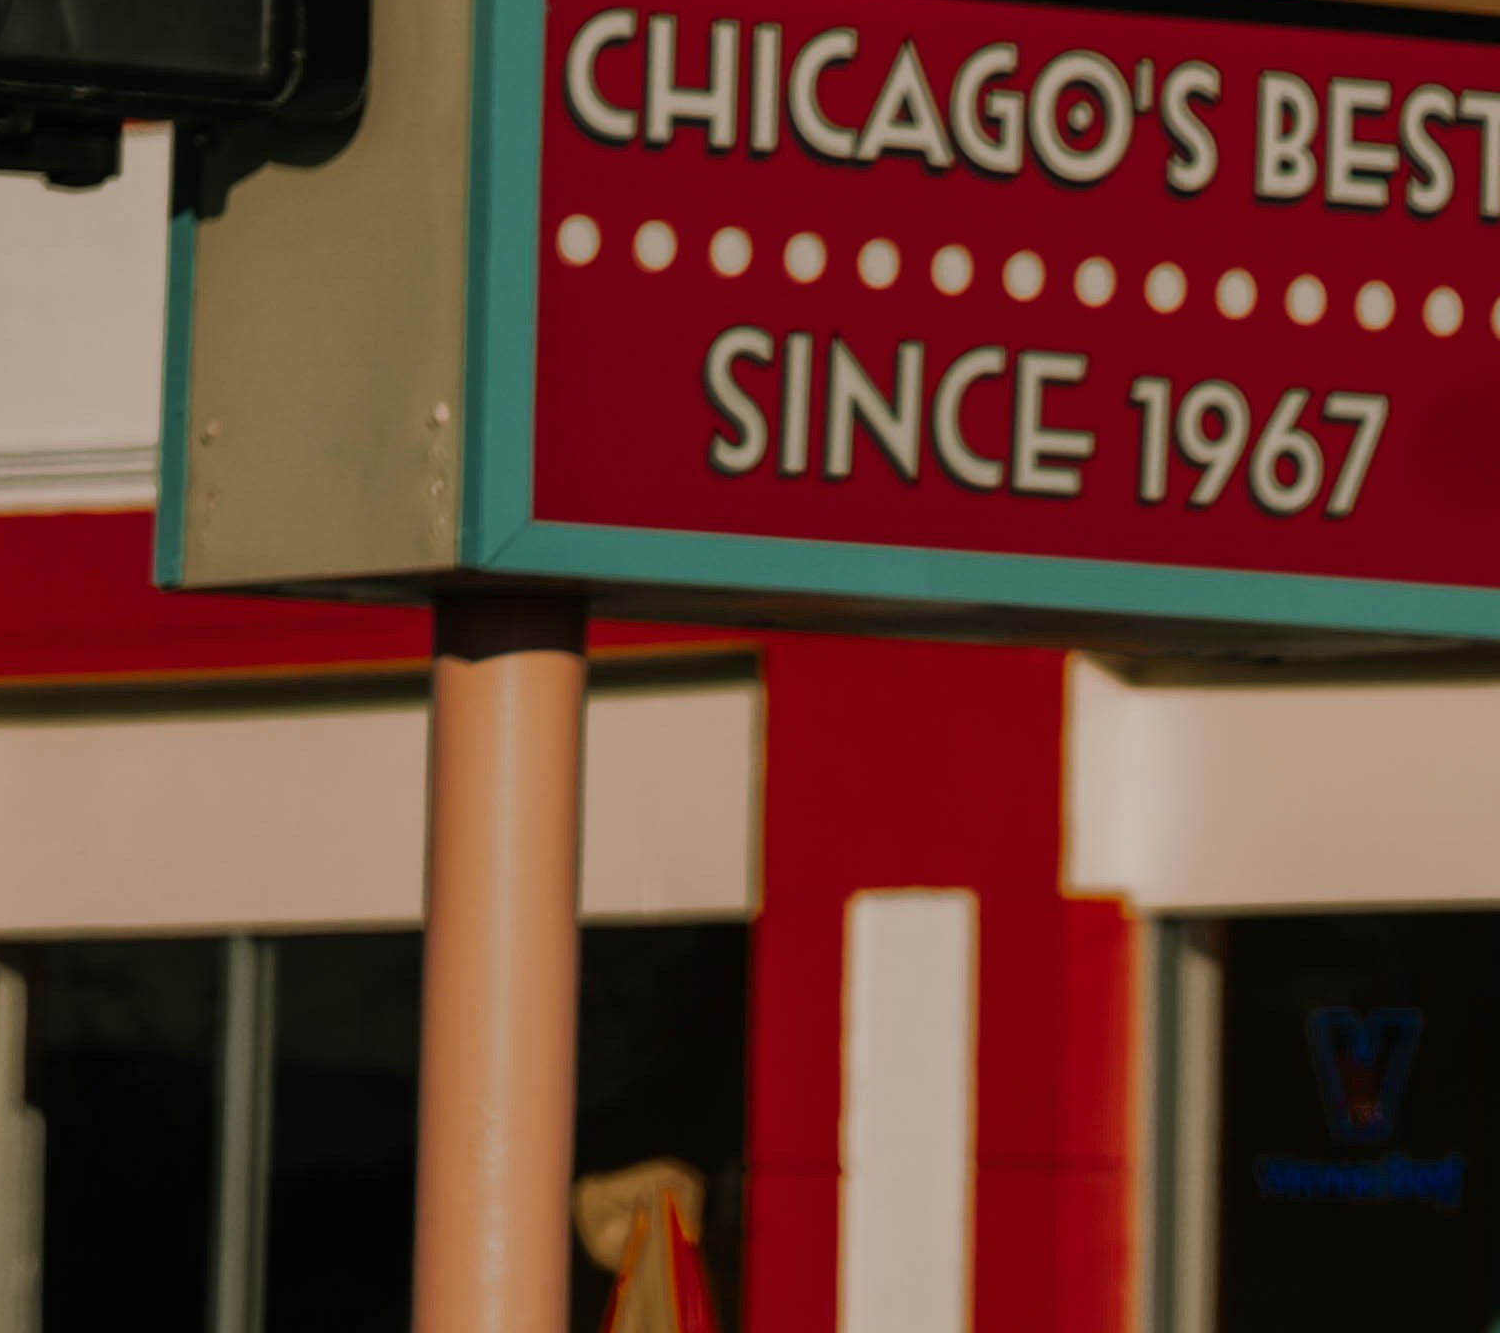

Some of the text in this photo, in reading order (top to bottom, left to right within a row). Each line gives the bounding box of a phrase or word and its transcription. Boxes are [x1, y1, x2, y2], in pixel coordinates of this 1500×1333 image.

[560, 5, 1222, 197] CHICAGO'S
[702, 324, 1390, 520] SINCE 1967
